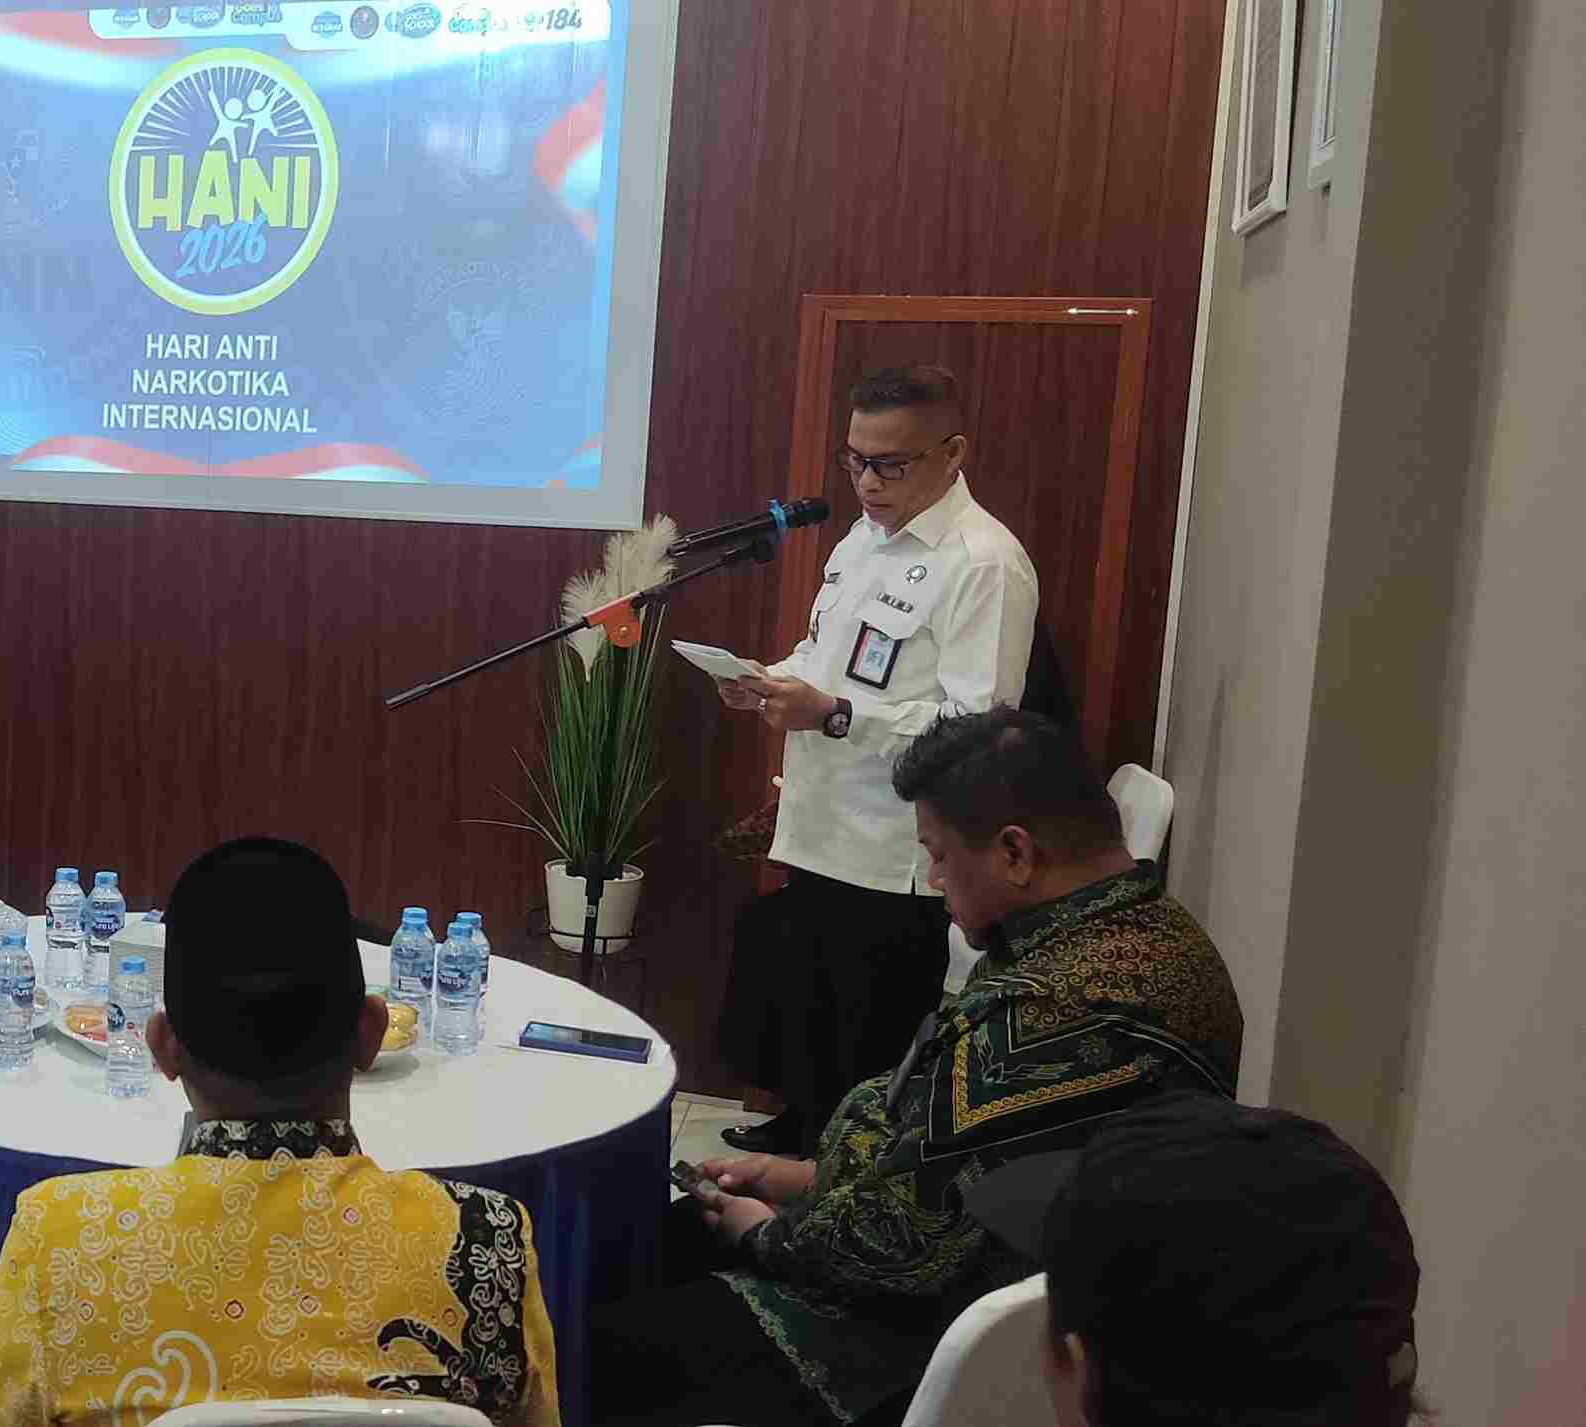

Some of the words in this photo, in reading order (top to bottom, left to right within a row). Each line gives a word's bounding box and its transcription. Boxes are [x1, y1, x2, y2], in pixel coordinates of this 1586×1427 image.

[546, 8, 583, 31] 184
[137, 150, 311, 232] HANI
[174, 212, 267, 279] 2026
[145, 333, 210, 360] HARI
[215, 334, 279, 361] ANTI
[131, 368, 290, 397] NARKOTIKA
[102, 403, 318, 433] INTERNASIONAL
